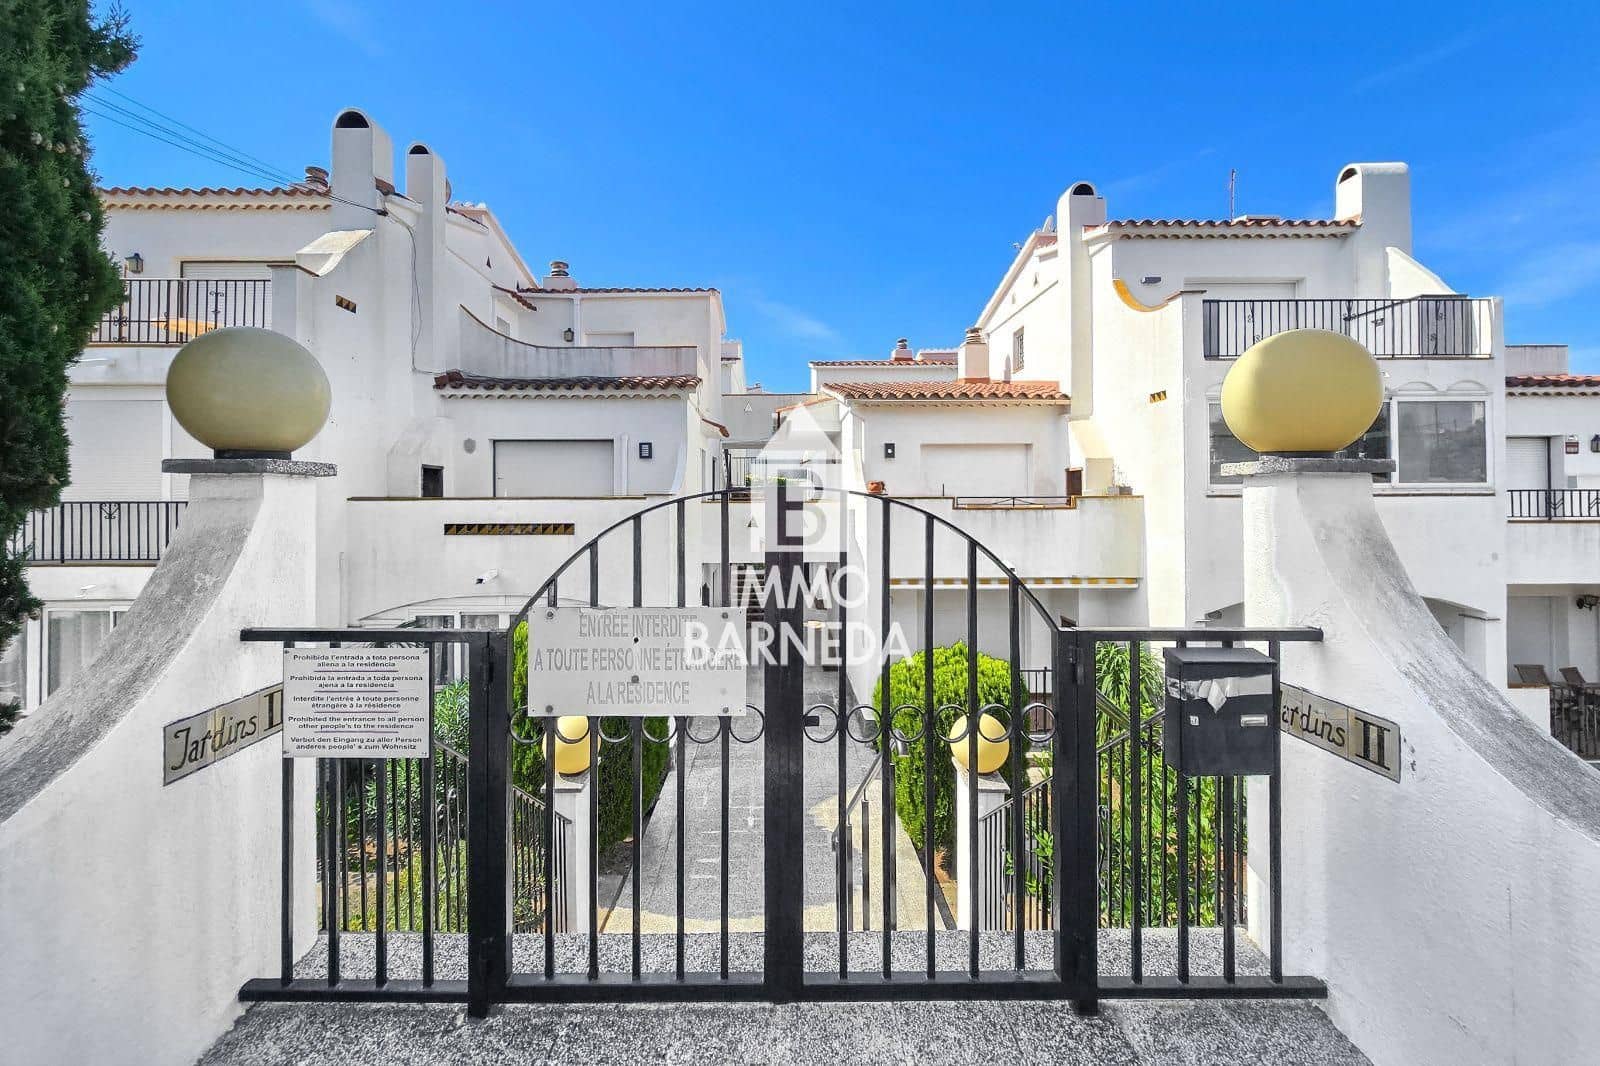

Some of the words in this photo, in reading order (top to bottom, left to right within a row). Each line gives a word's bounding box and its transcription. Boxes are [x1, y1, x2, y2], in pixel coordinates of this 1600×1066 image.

[547, 647, 588, 671] TOUTE
[592, 647, 661, 671] PERSONNE
[598, 681, 614, 704] LA
[333, 736, 365, 744] Eingang
[1280, 690, 1346, 748] ardins
[1354, 716, 1391, 771] II
[171, 716, 258, 771] Jardins
